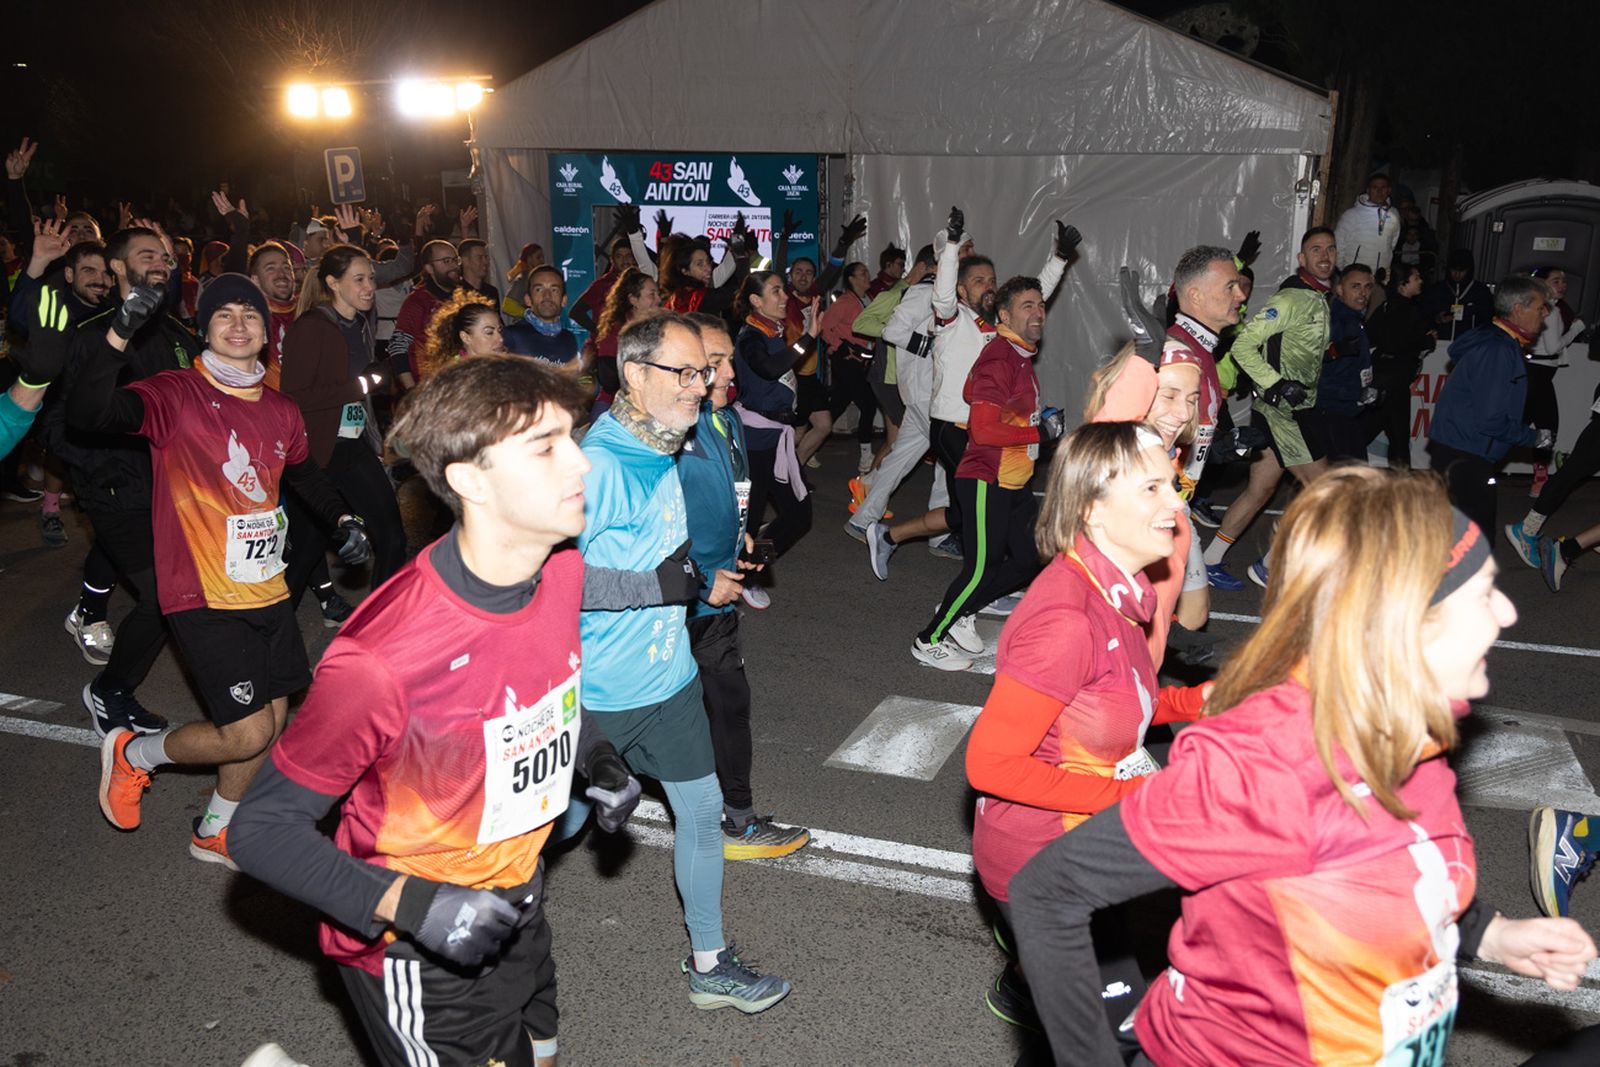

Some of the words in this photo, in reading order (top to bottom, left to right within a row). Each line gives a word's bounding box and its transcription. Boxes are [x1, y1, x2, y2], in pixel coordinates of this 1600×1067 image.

[334, 154, 355, 197] P
[648, 161, 673, 182] 43
[673, 161, 714, 181] SAN
[644, 178, 710, 202] ANTÓN
[553, 225, 590, 234] calderón
[237, 471, 256, 493] 43
[236, 531, 253, 540] SAN
[503, 743, 526, 762] SAN
[512, 730, 571, 794] 5070
